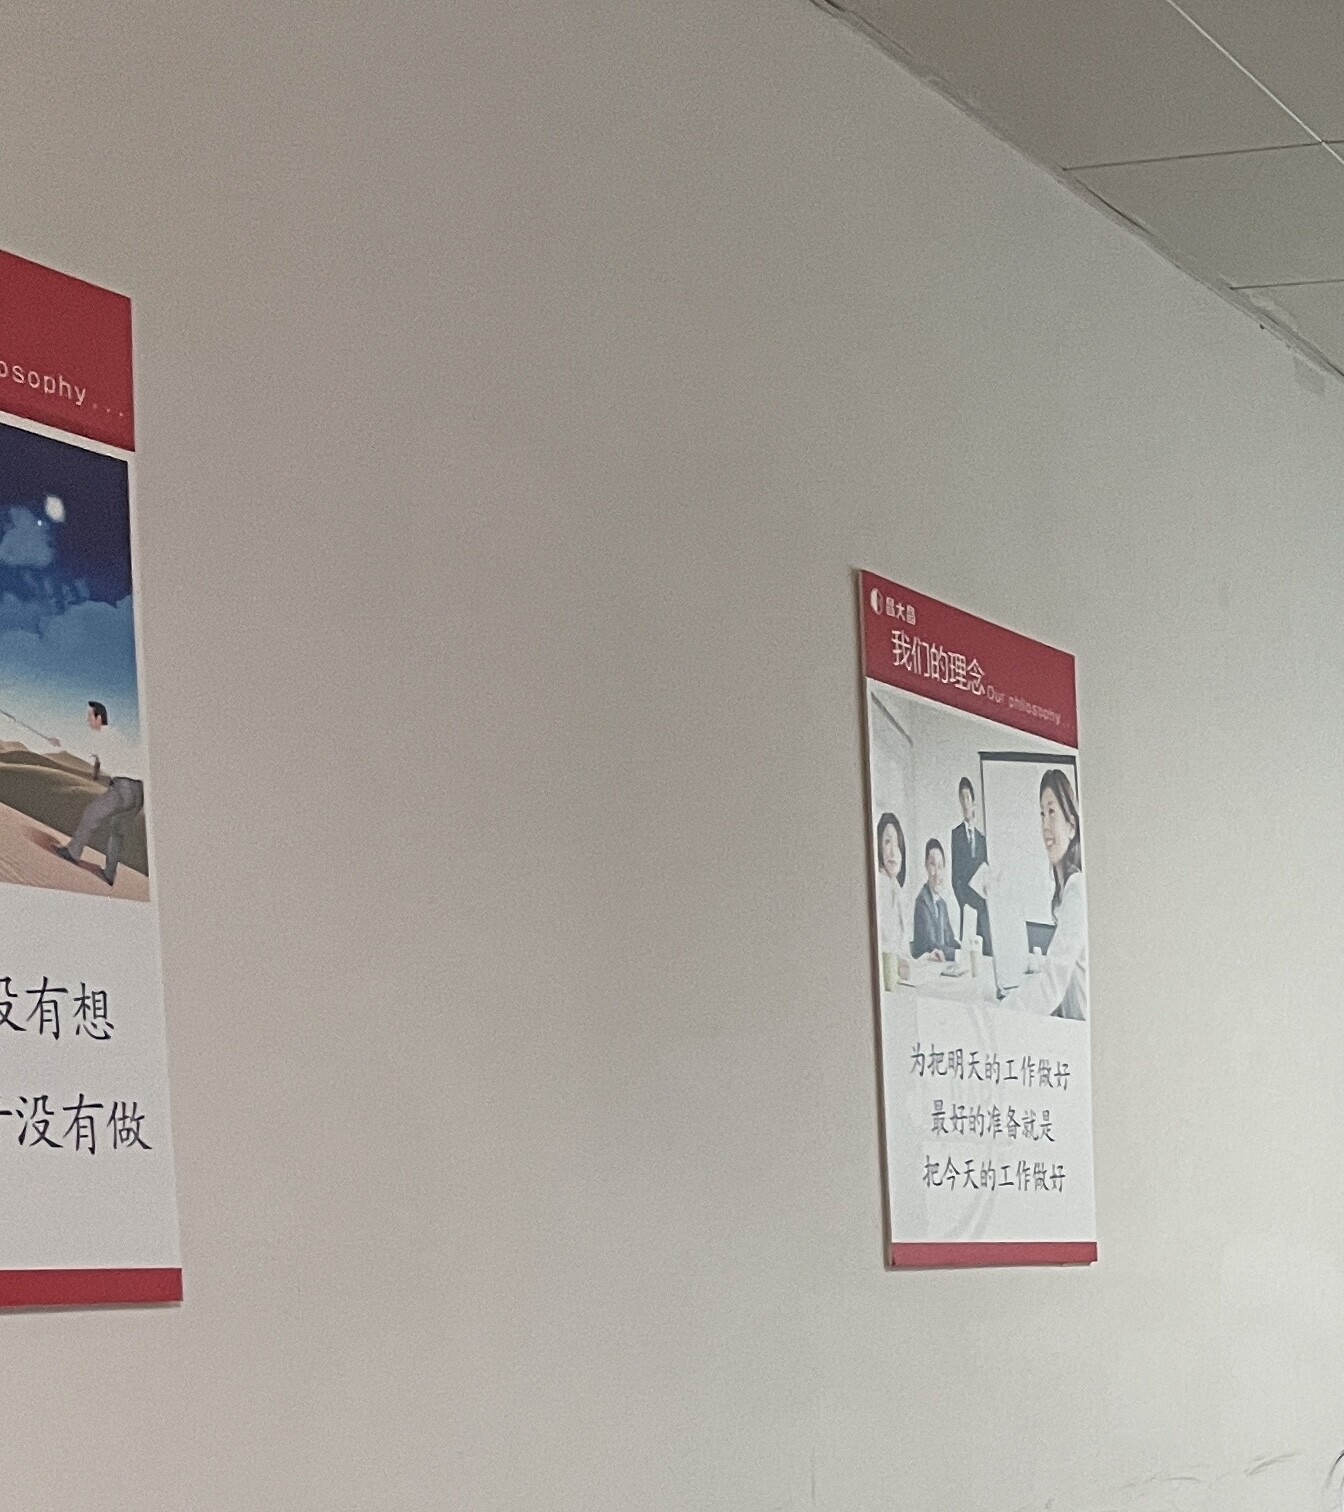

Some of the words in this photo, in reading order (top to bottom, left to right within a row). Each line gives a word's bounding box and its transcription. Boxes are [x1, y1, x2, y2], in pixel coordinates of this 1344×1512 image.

[890, 629, 986, 696] 我们的理念
[909, 1042, 1071, 1091] 为把明天的工作做好
[0, 1092, 153, 1155] 没有做
[930, 1098, 1055, 1142] 最好的准备就是
[922, 1154, 1067, 1193] 把今天的工作做好
